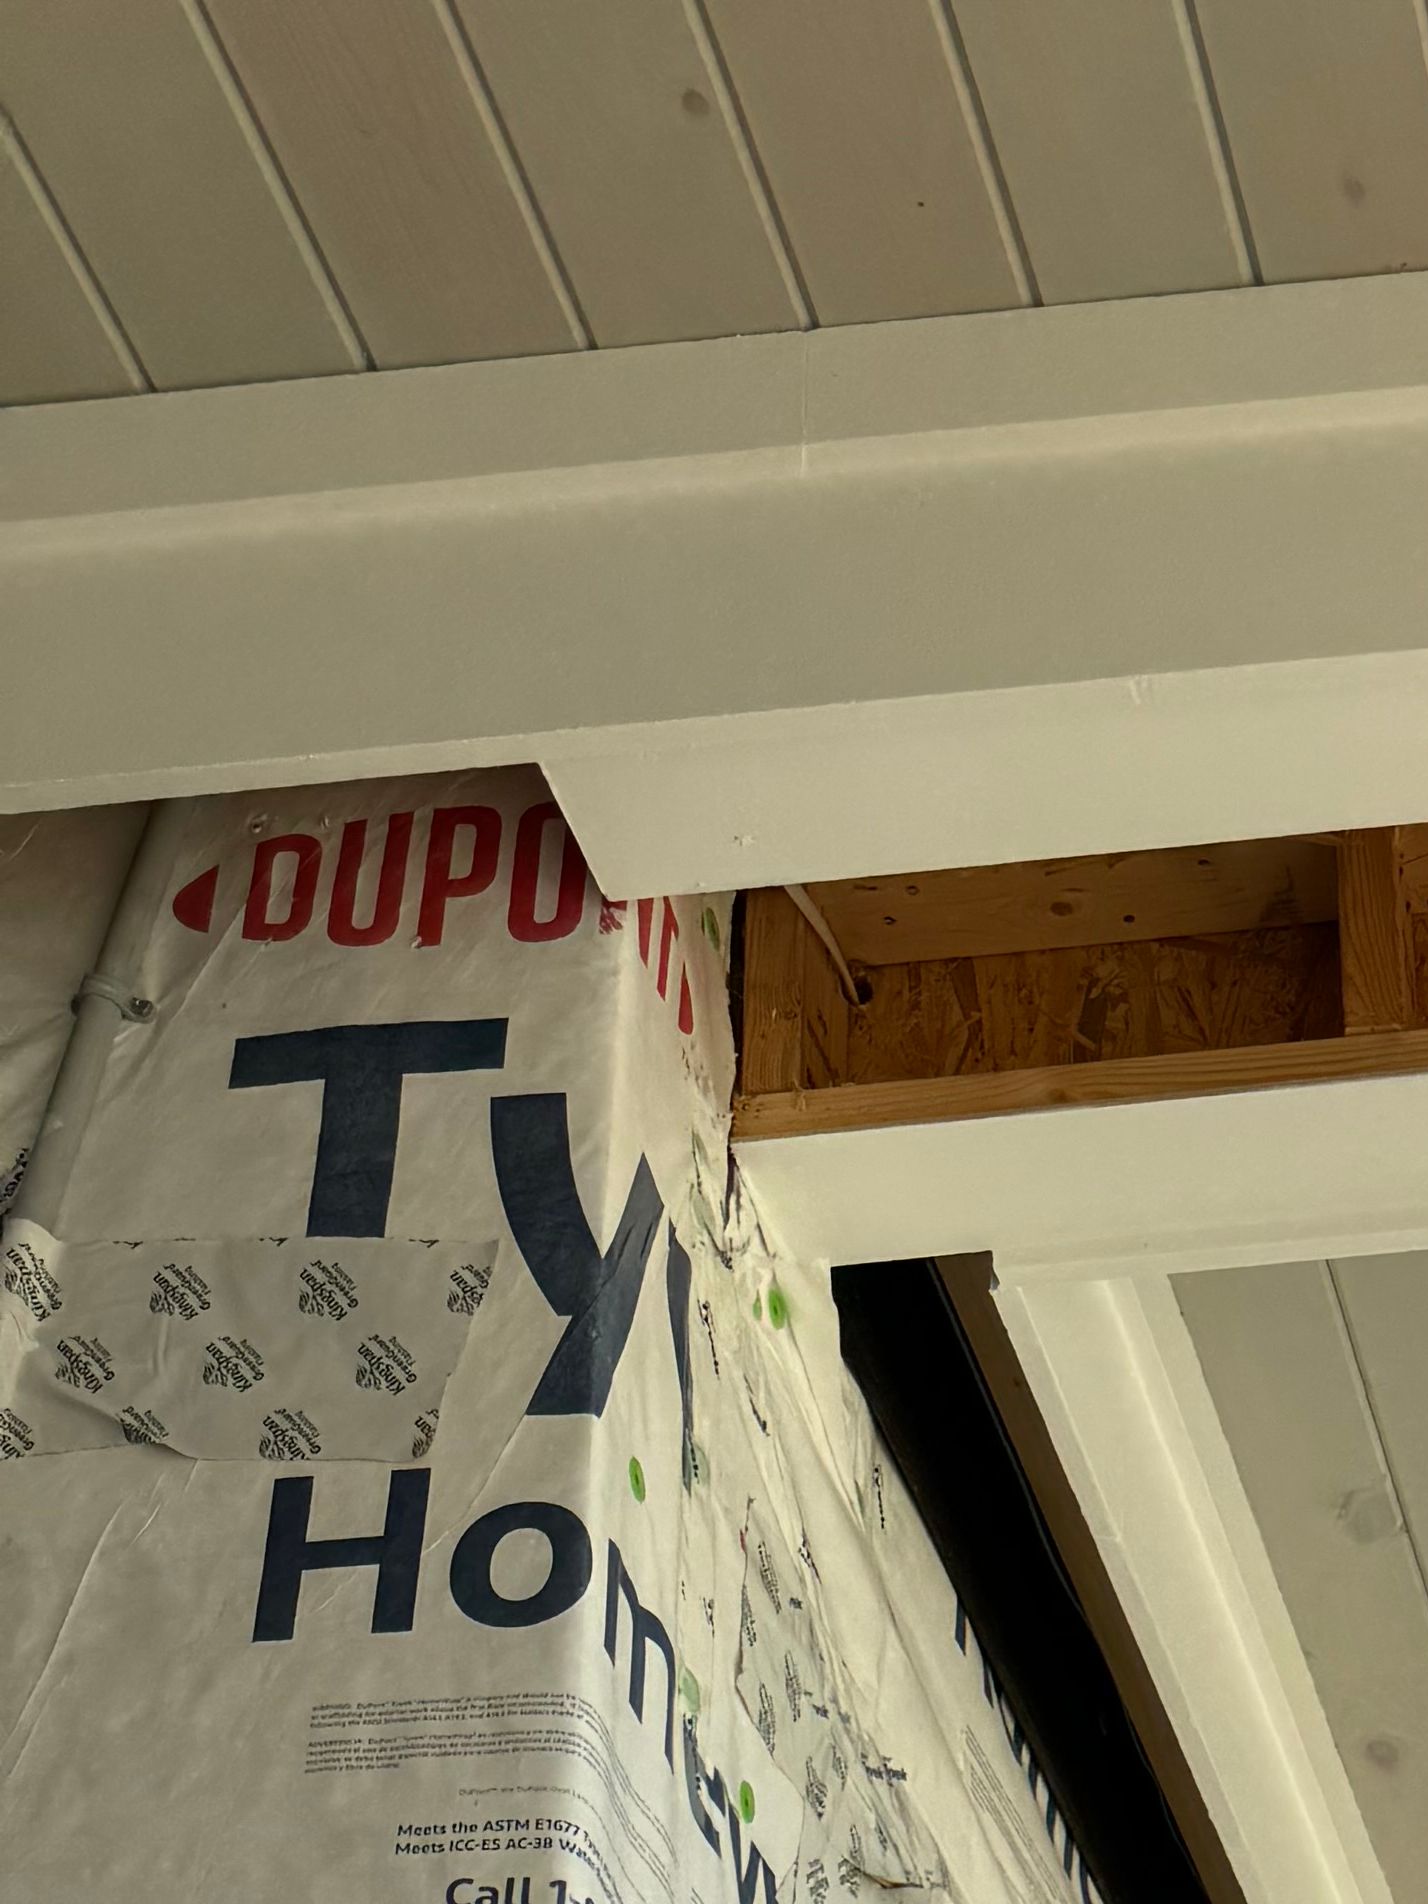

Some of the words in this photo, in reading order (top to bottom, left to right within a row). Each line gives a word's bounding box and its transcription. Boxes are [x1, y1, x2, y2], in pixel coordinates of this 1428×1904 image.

[241, 802, 690, 1034] DUPO
[300, 1268, 347, 1320] Kingspan
[358, 1342, 405, 1395] Kingspan
[263, 1416, 311, 1460] ingspan
[395, 1841, 445, 1855] Meets
[397, 1824, 446, 1837] Meets
[452, 1822, 477, 1834] the
[483, 1819, 530, 1832] ASTM
